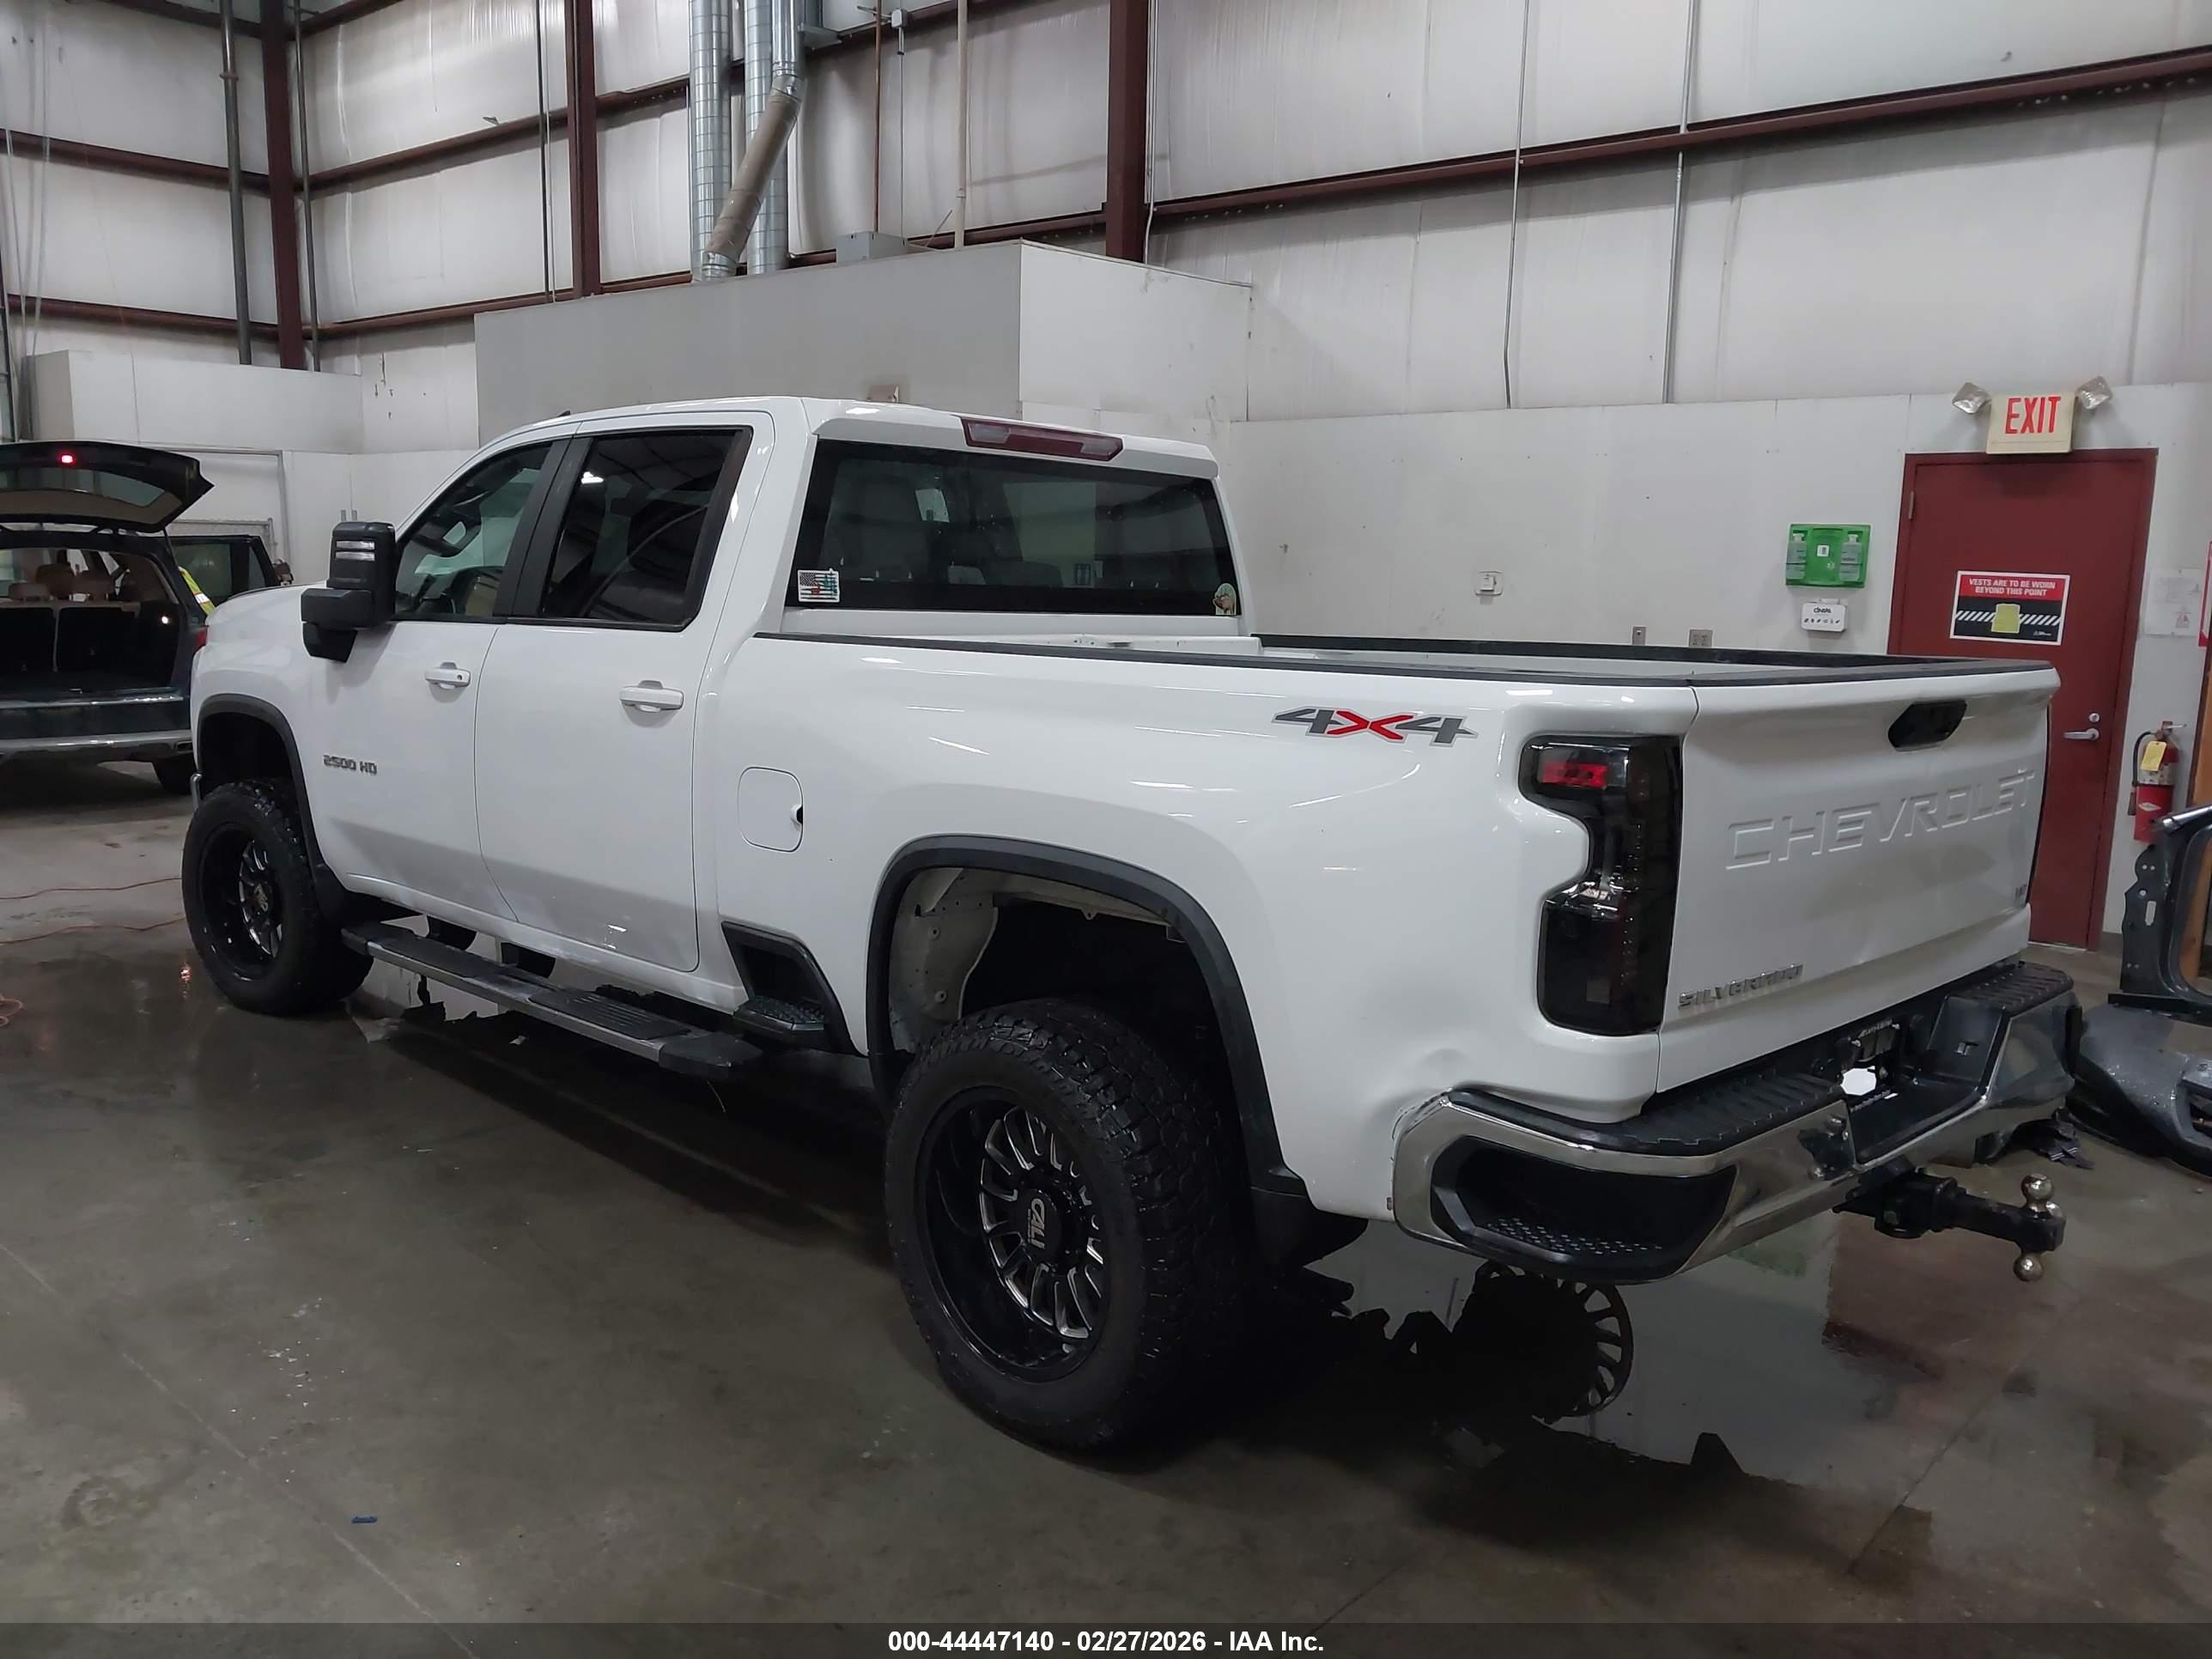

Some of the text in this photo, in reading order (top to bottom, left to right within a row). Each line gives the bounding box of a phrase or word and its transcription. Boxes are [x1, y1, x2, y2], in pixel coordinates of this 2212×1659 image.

[2005, 396, 2061, 434] EXIT
[1969, 578, 1991, 586] VESTS
[1992, 579, 2008, 587] ARE
[323, 755, 378, 775] 2500 HD
[1726, 769, 2035, 870] CHEVROLET
[1030, 1199, 1045, 1249] CALI
